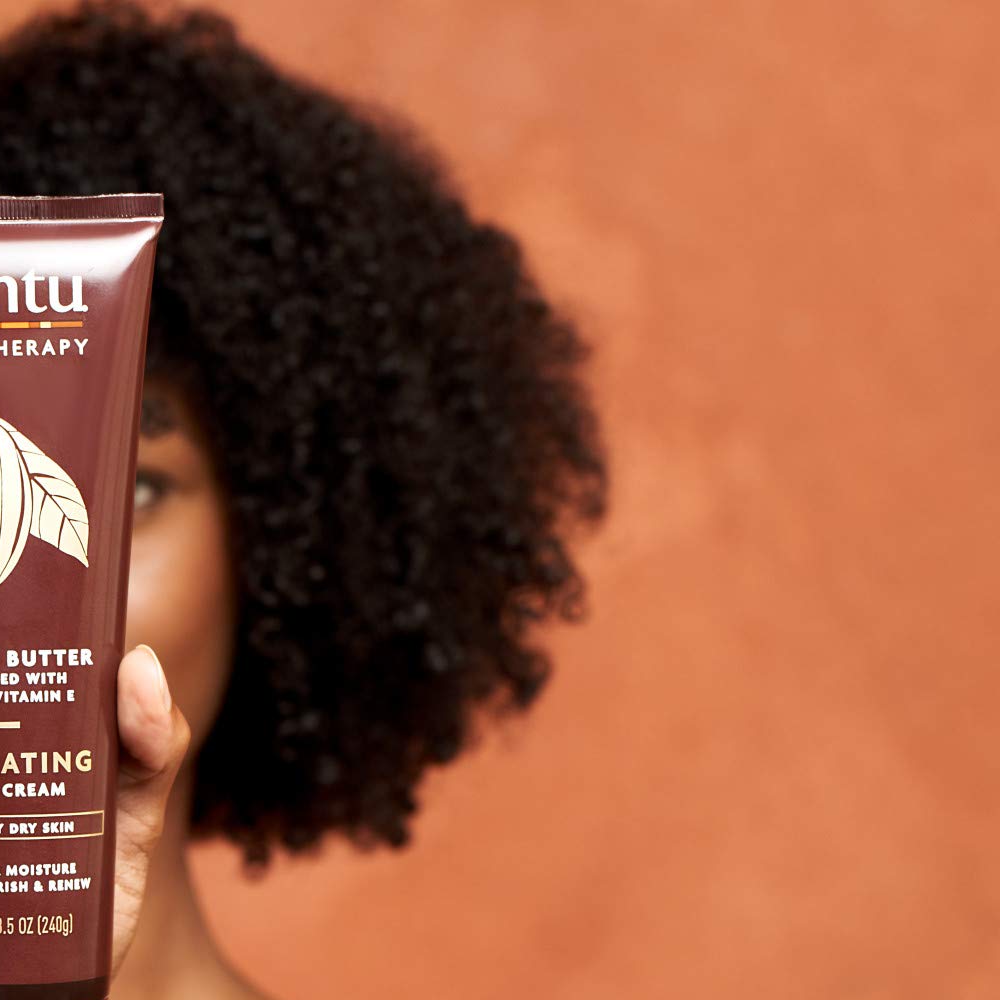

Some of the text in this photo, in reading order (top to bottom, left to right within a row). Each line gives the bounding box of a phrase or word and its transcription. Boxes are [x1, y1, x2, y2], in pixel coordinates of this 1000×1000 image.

[6, 648, 94, 668] BUTTER
[25, 672, 68, 685] WITH
[66, 689, 76, 702] E
[2, 781, 66, 798] CREAM
[9, 822, 38, 835] DRY
[42, 821, 75, 834] SKIN
[5, 862, 77, 877] MOISTURE
[33, 880, 44, 893] &
[48, 877, 92, 892] RENEW
[18, 916, 34, 935] OZ
[37, 913, 73, 937] (240g)
